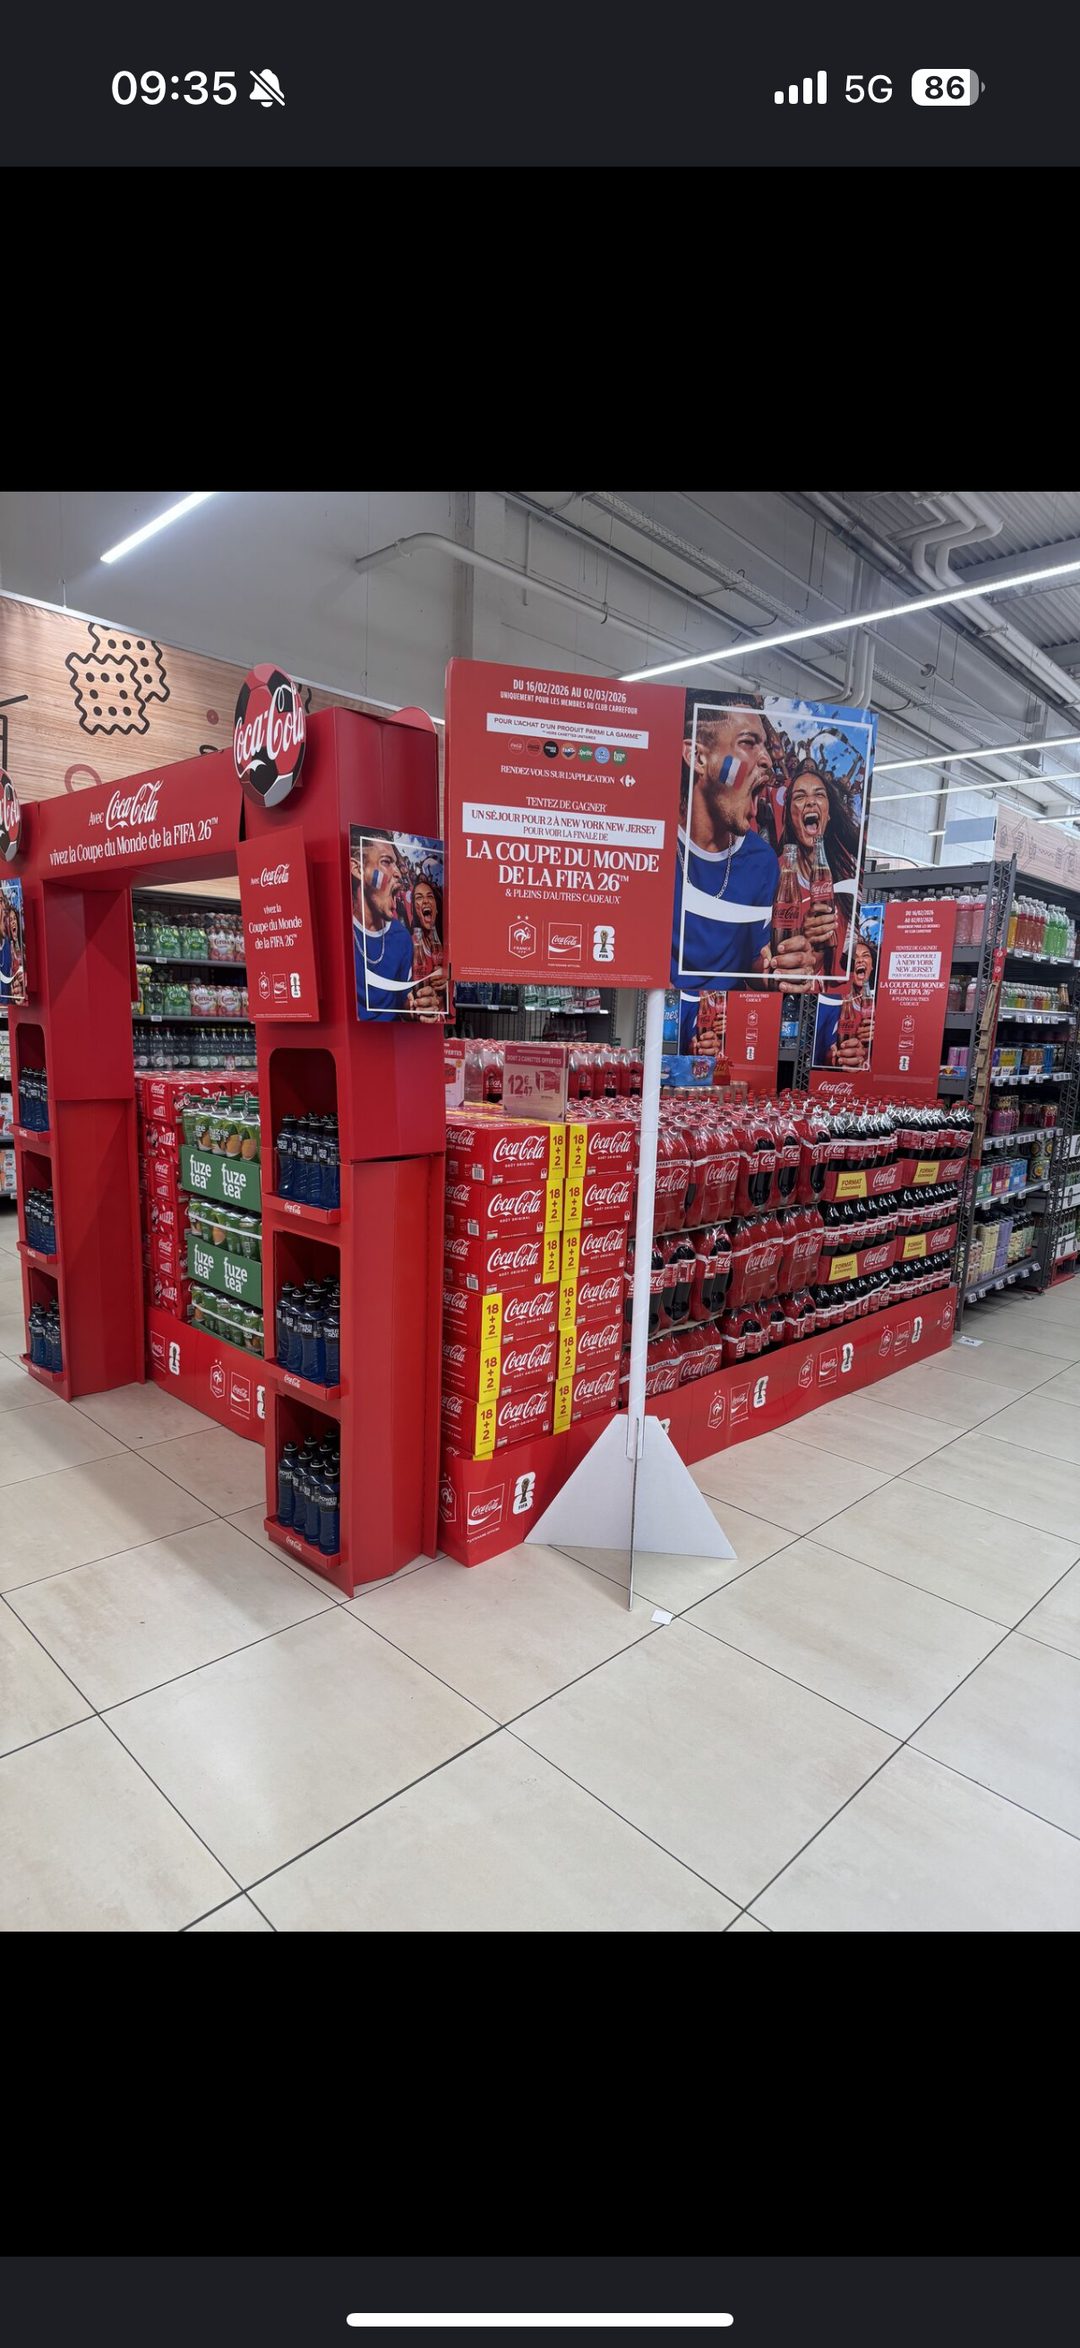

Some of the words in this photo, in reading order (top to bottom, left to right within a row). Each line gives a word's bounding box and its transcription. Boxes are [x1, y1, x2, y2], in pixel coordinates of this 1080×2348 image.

[513, 679, 524, 690] DU
[526, 680, 569, 696] 16/02/2026
[571, 687, 582, 698] AU
[584, 688, 626, 704] 02/03/2026
[500, 691, 534, 702] UNIQUEMENT
[550, 697, 560, 705] LES
[561, 698, 585, 708] MEMBRES
[587, 702, 594, 710] DU
[595, 703, 608, 712] CLUB
[609, 705, 637, 714] CARREFOUR
[234, 684, 305, 778] Coca-Cola
[494, 717, 512, 725] POUR
[514, 719, 538, 729] L'ACHAT
[540, 722, 556, 730] D'UN
[557, 724, 584, 734] PRODUIT
[585, 728, 605, 736] PARMI
[500, 765, 550, 777] RENDEZ-VOUS
[550, 769, 565, 779] SUR
[565, 772, 615, 784] L'APPLICATION
[89, 810, 104, 826] Avec
[106, 780, 164, 830] Coca-Cola
[526, 796, 560, 808] TENTEZ
[560, 800, 571, 810] DE
[471, 810, 485, 820] UN
[485, 809, 521, 823] SÉJOUR
[522, 814, 546, 825] POUR
[547, 817, 552, 825] 2
[553, 816, 561, 827] À
[561, 818, 581, 828] NEW
[582, 820, 605, 830] YORK
[606, 821, 626, 832] NEW
[626, 822, 657, 835] JERSEY
[523, 826, 544, 836] POUR
[544, 828, 562, 837] VOIR
[562, 830, 572, 838] LA
[573, 830, 598, 840] FINALE
[598, 833, 608, 841] DE
[50, 850, 68, 866] vivez
[69, 845, 76, 862] la
[77, 843, 103, 865] Coupe
[104, 838, 116, 857] du
[116, 832, 147, 855] Monde
[149, 829, 161, 849] de
[163, 827, 172, 846] la
[173, 823, 196, 846] FIFA
[466, 839, 493, 859] LA
[496, 842, 561, 865] COUPE
[564, 848, 590, 867] DU
[593, 850, 660, 872] MONDE
[260, 864, 290, 887] Coca-Cola
[498, 865, 524, 885] DE
[527, 868, 552, 887] LA
[556, 869, 594, 890] FIFA
[513, 889, 542, 899] PLEINS
[543, 892, 581, 902] D'AUTRES
[248, 921, 268, 934] Coupe
[269, 919, 278, 932] du
[278, 916, 302, 930] Monde
[254, 938, 263, 949] de
[263, 937, 270, 949] la
[270, 936, 285, 948] FIFA
[551, 934, 577, 946] Coca-Cola
[818, 1081, 855, 1096] Coca-Cola
[553, 1135, 563, 1146] 18
[574, 1134, 584, 1144] 18
[589, 1130, 632, 1155] Coca-Cola
[493, 1135, 548, 1163] Coca-Cola
[190, 1154, 211, 1174] fuze
[554, 1156, 560, 1166] 2
[575, 1155, 581, 1165] 2
[191, 1173, 208, 1189] tea
[221, 1163, 246, 1185] fuze
[222, 1183, 242, 1200] tea
[550, 1189, 560, 1199] 18
[569, 1187, 580, 1197] 18
[584, 1181, 632, 1207] Coca-Cola
[487, 1190, 544, 1218] Coca-Cola
[571, 1207, 577, 1216] 2
[551, 1209, 557, 1219] 2
[547, 1240, 557, 1250] 18
[566, 1237, 577, 1247] 18
[582, 1228, 626, 1256] Coca-Cola
[194, 1244, 214, 1264] fuze
[487, 1242, 542, 1273] Coca-Cola
[568, 1257, 574, 1267] 2
[195, 1263, 211, 1280] tea
[224, 1256, 248, 1278] fuze
[549, 1260, 555, 1270] 2
[225, 1276, 243, 1293] tea
[563, 1287, 574, 1297] 18
[579, 1275, 622, 1305] Coca-Cola
[487, 1304, 499, 1314] 18
[504, 1291, 556, 1322] Coca-Cola
[565, 1307, 571, 1316] 2
[489, 1325, 496, 1335] 2
[578, 1322, 622, 1353] Coca-Cola
[564, 1336, 574, 1346] 18
[484, 1357, 497, 1368] 18
[503, 1342, 554, 1375] Coca-Cola
[564, 1356, 570, 1366] 2
[487, 1378, 494, 1388] 2
[559, 1385, 569, 1395] 18
[574, 1370, 617, 1401] Coca-Cola
[481, 1409, 493, 1419] 18
[498, 1390, 550, 1426] Coca-Cola
[560, 1405, 566, 1414] 2
[483, 1430, 490, 1440] 2
[471, 1498, 500, 1518] Coca-Cola
